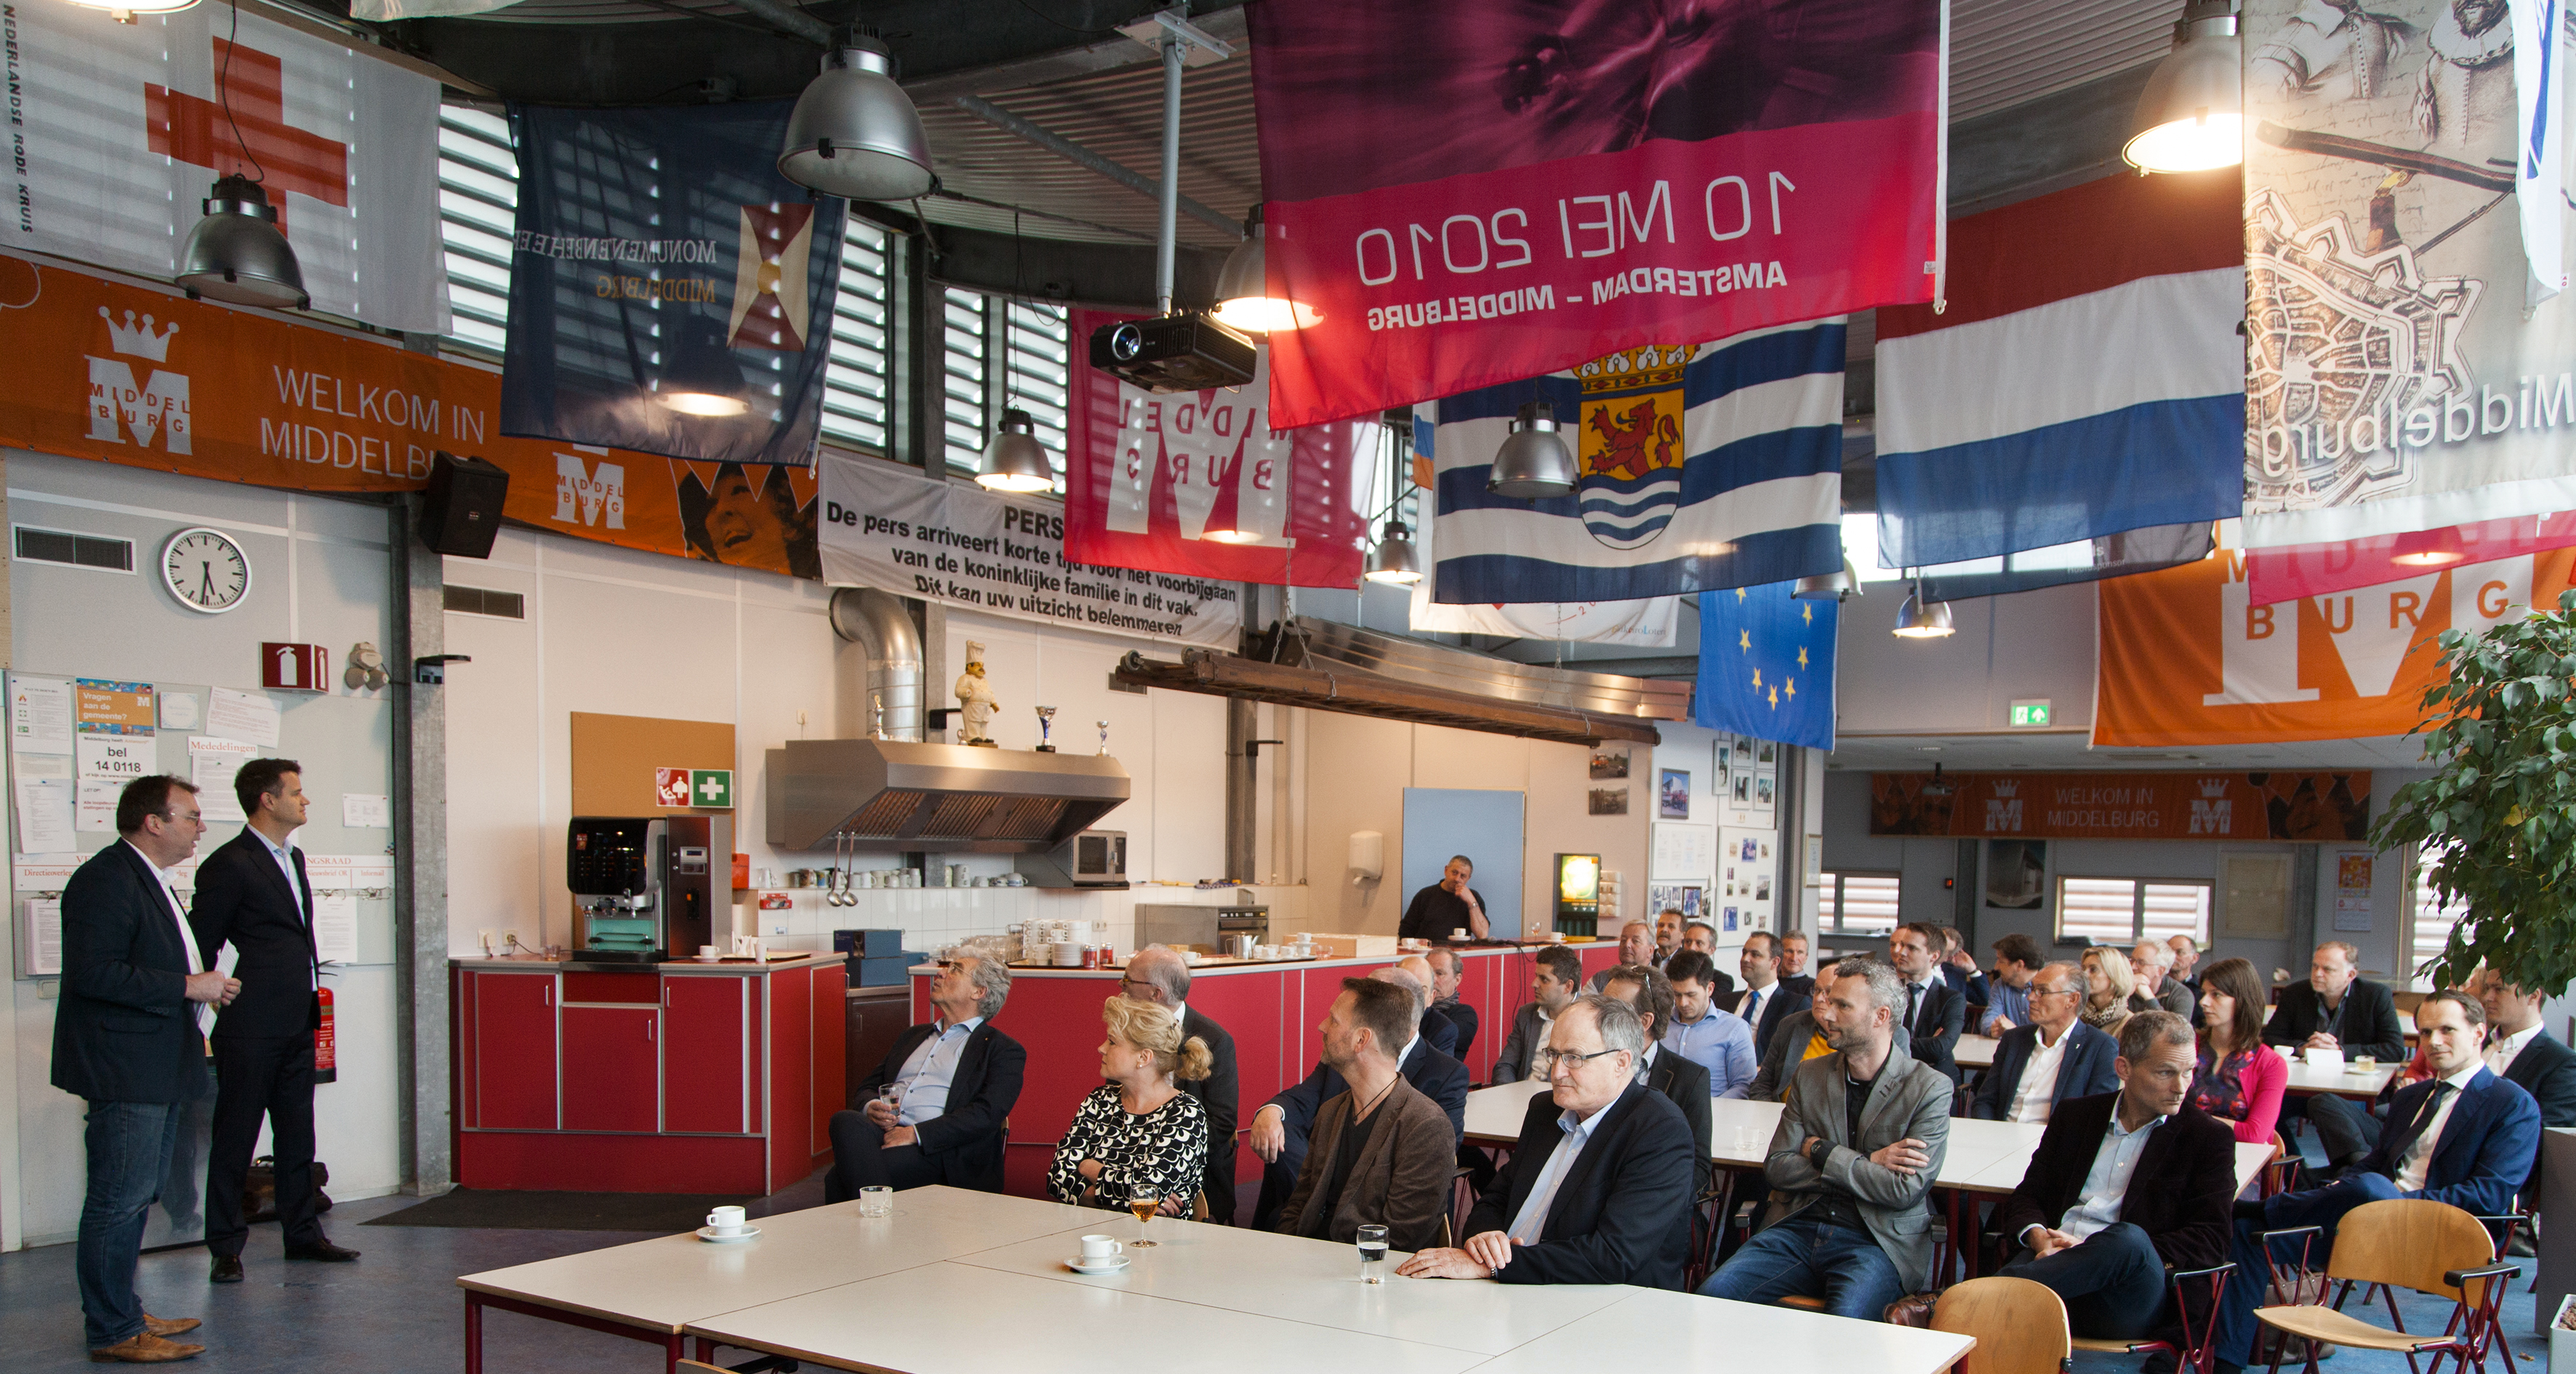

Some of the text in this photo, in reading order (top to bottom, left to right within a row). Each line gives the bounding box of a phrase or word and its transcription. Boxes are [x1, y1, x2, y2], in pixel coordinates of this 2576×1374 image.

[4, 3, 33, 233] NEDERLANDSE RODE KRUIS
[90, 382, 190, 414] MIDDEL
[273, 365, 484, 444] WELKOM IN
[98, 404, 184, 433] BURG
[261, 417, 436, 480] MIDDELB
[558, 475, 624, 498] MIDDEL
[563, 491, 619, 513] BURG
[827, 501, 857, 526] De
[863, 513, 910, 535] pers
[916, 525, 998, 555] arriveert
[1004, 538, 1051, 564] korte
[1156, 572, 1236, 602] voorbijgaan
[891, 547, 1197, 616] van de koninklijke familie in dit vak.
[915, 574, 1182, 636] Dit kan uw uitzicht belemmeren
[2246, 580, 2510, 640] BURG
[83, 692, 111, 702] Vragen
[83, 712, 127, 721] gemeente?
[108, 747, 127, 758] bel
[190, 741, 256, 753] Mededelingen
[95, 760, 142, 772] 14 0118
[2056, 787, 2154, 805] WELKOM IN
[2047, 810, 2159, 828] MIDDELBURG
